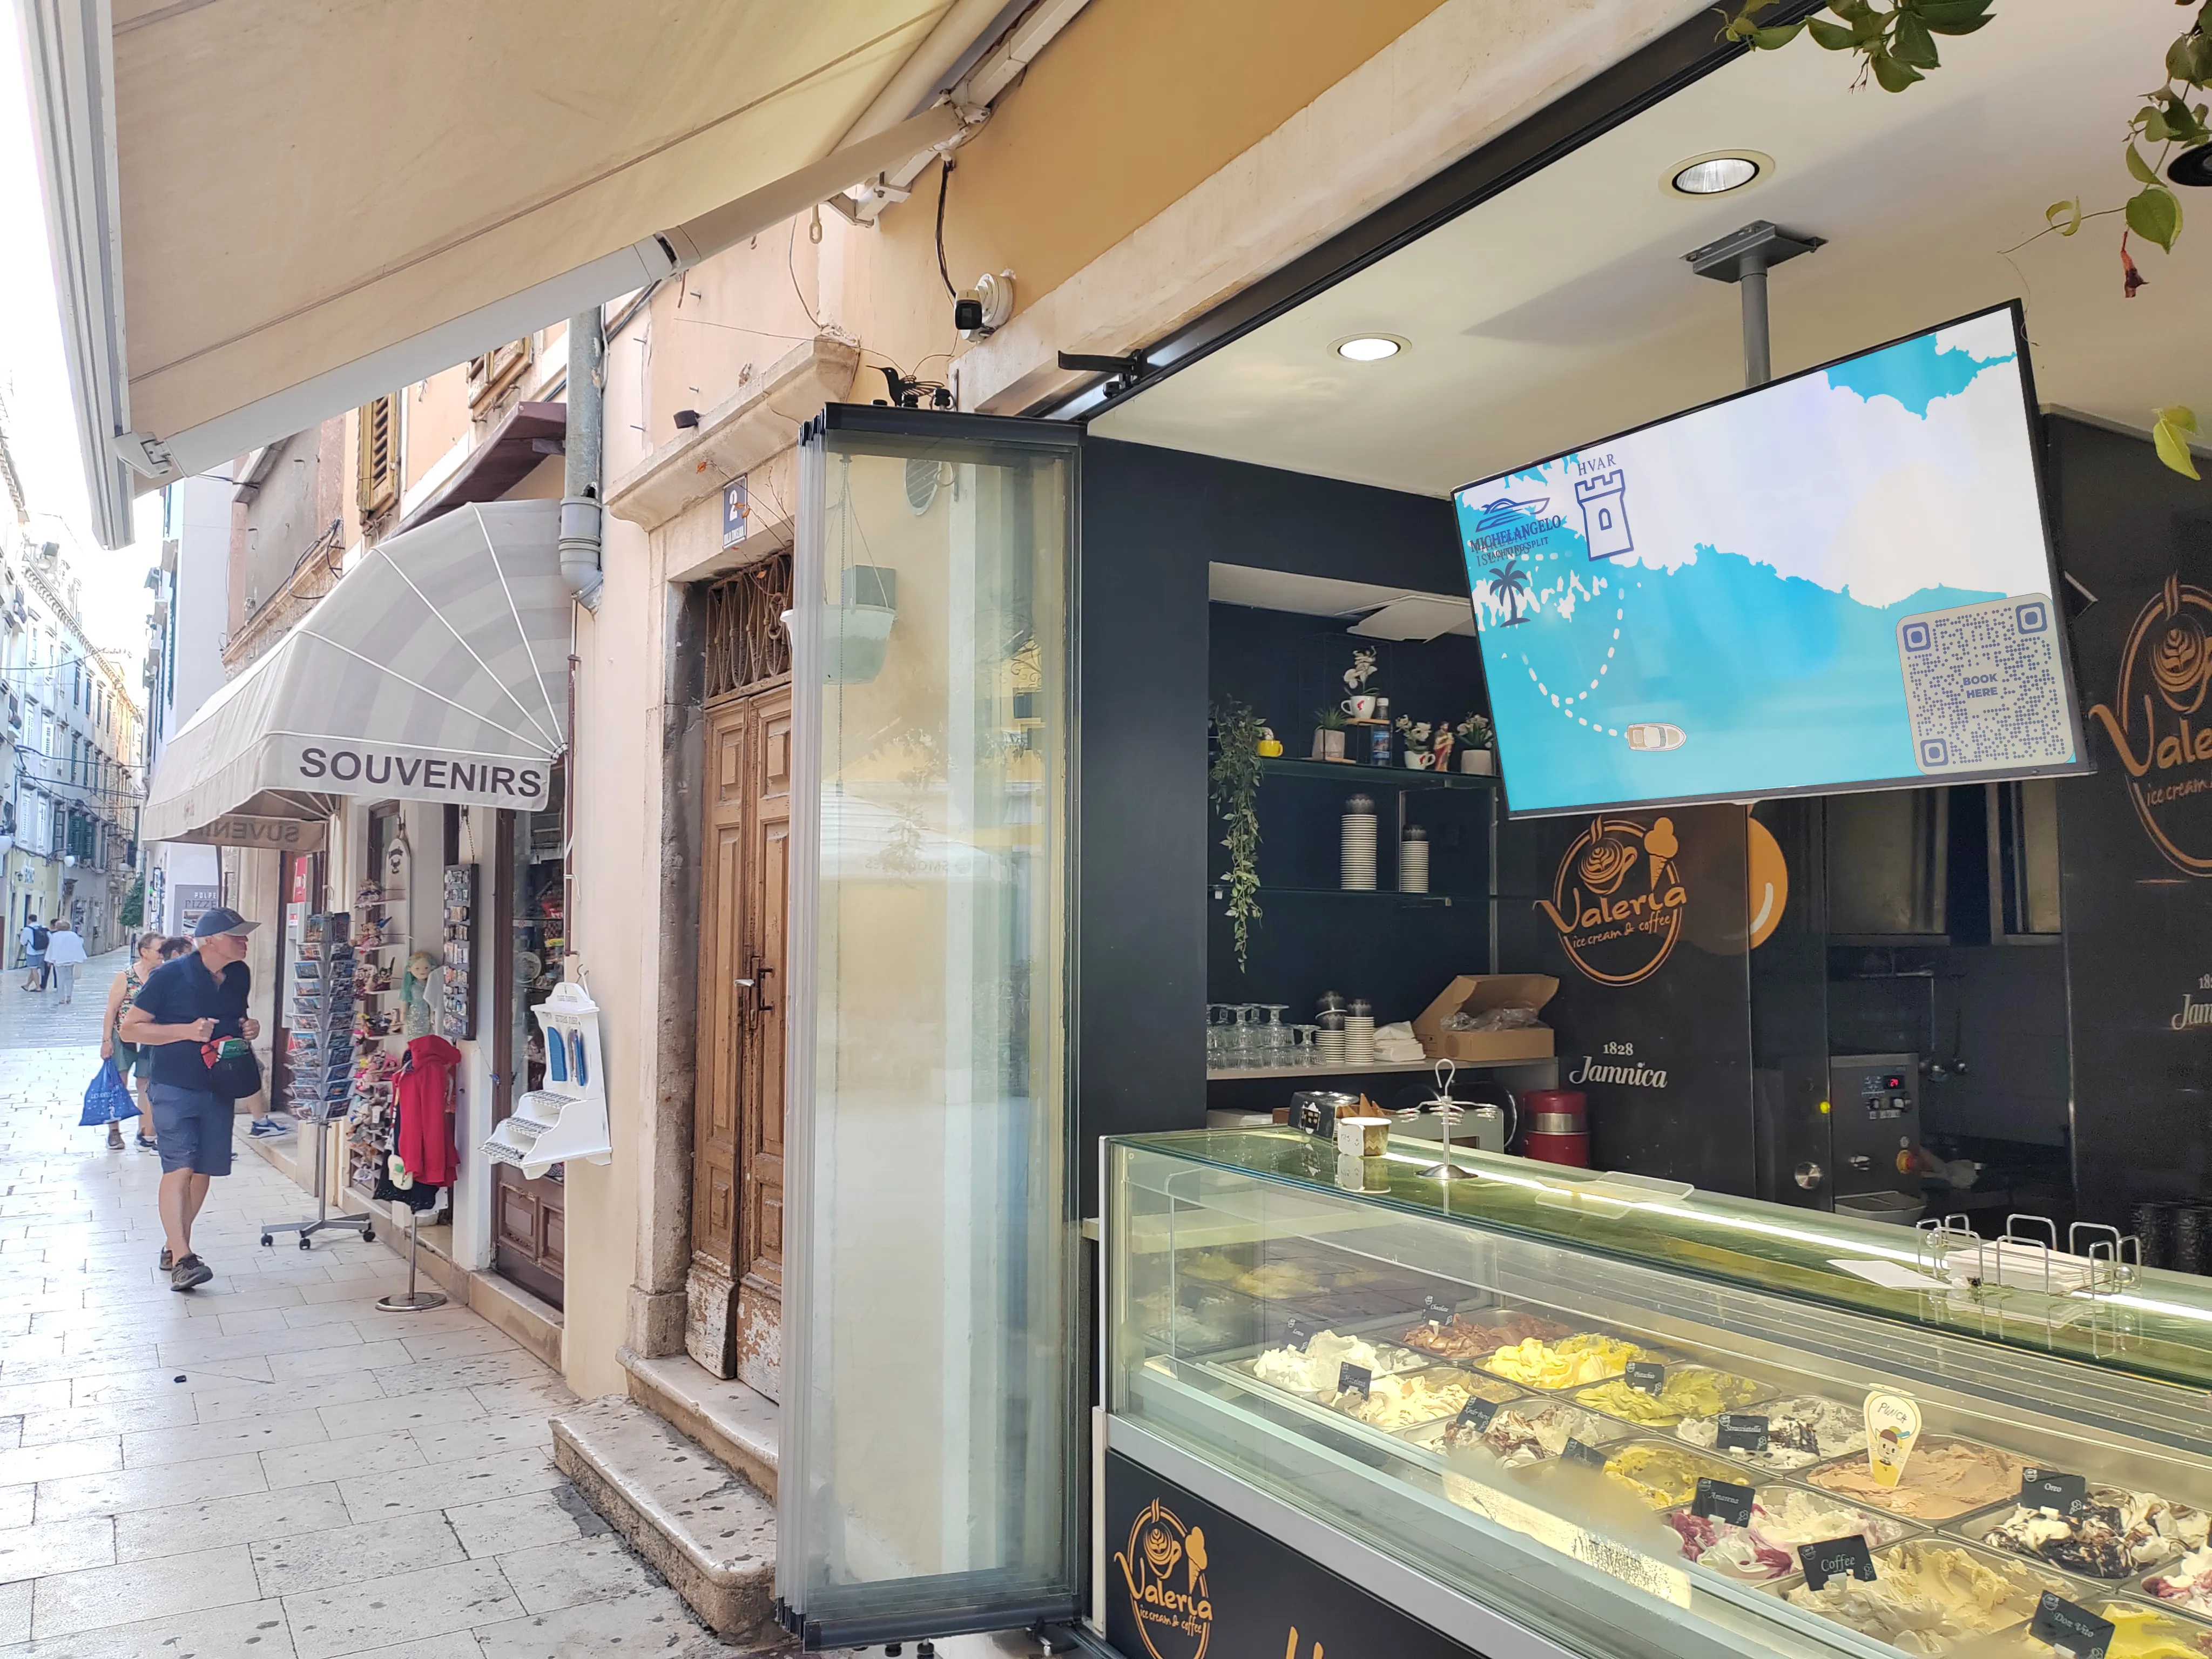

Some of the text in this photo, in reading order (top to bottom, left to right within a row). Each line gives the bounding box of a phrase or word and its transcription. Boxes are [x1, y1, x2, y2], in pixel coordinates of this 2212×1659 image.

[1577, 454, 1616, 476] HVAR
[729, 489, 738, 522] 2
[1469, 515, 1561, 552] MICHELANGELO
[1963, 673, 1999, 686] BOOK
[1966, 686, 1999, 699] HERE
[299, 747, 541, 798] SOUVENIRS
[2147, 779, 2207, 806] ice cream
[1532, 886, 1688, 933] Valeria
[1573, 910, 1671, 948] ice cream & coffee
[1603, 1041, 1634, 1056] 1828
[1569, 1056, 1668, 1088] Jamnica
[1708, 1492, 1739, 1505] Amarena
[1821, 1554, 1856, 1573] Coffee
[1114, 1551, 1213, 1621] Valeria
[1140, 1604, 1149, 1619] ice
[1149, 1611, 1171, 1625] cream
[1181, 1615, 1202, 1637] coffee
